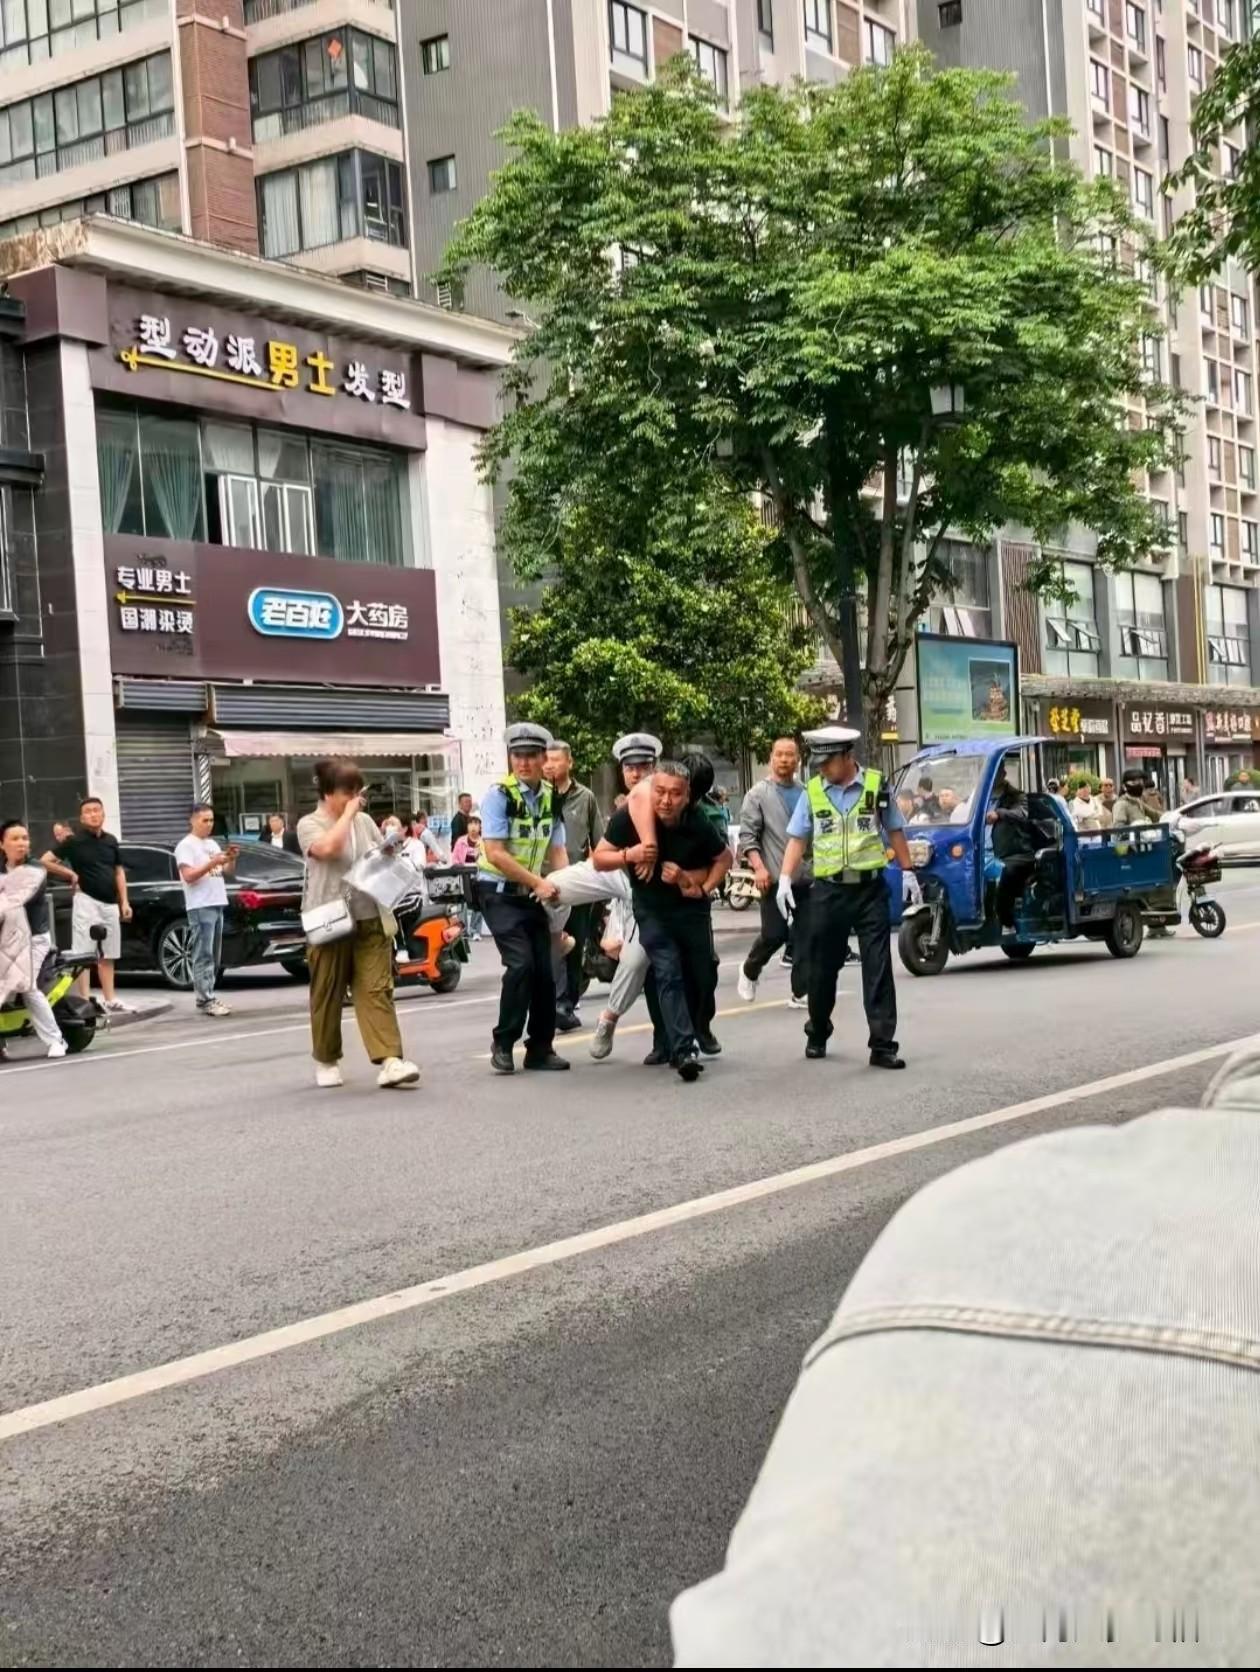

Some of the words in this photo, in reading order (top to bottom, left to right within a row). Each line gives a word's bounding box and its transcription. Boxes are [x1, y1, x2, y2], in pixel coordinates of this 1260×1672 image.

[139, 314, 410, 411] 型动派男士发型
[117, 566, 191, 594] 专业男士
[346, 599, 409, 629] 大药房
